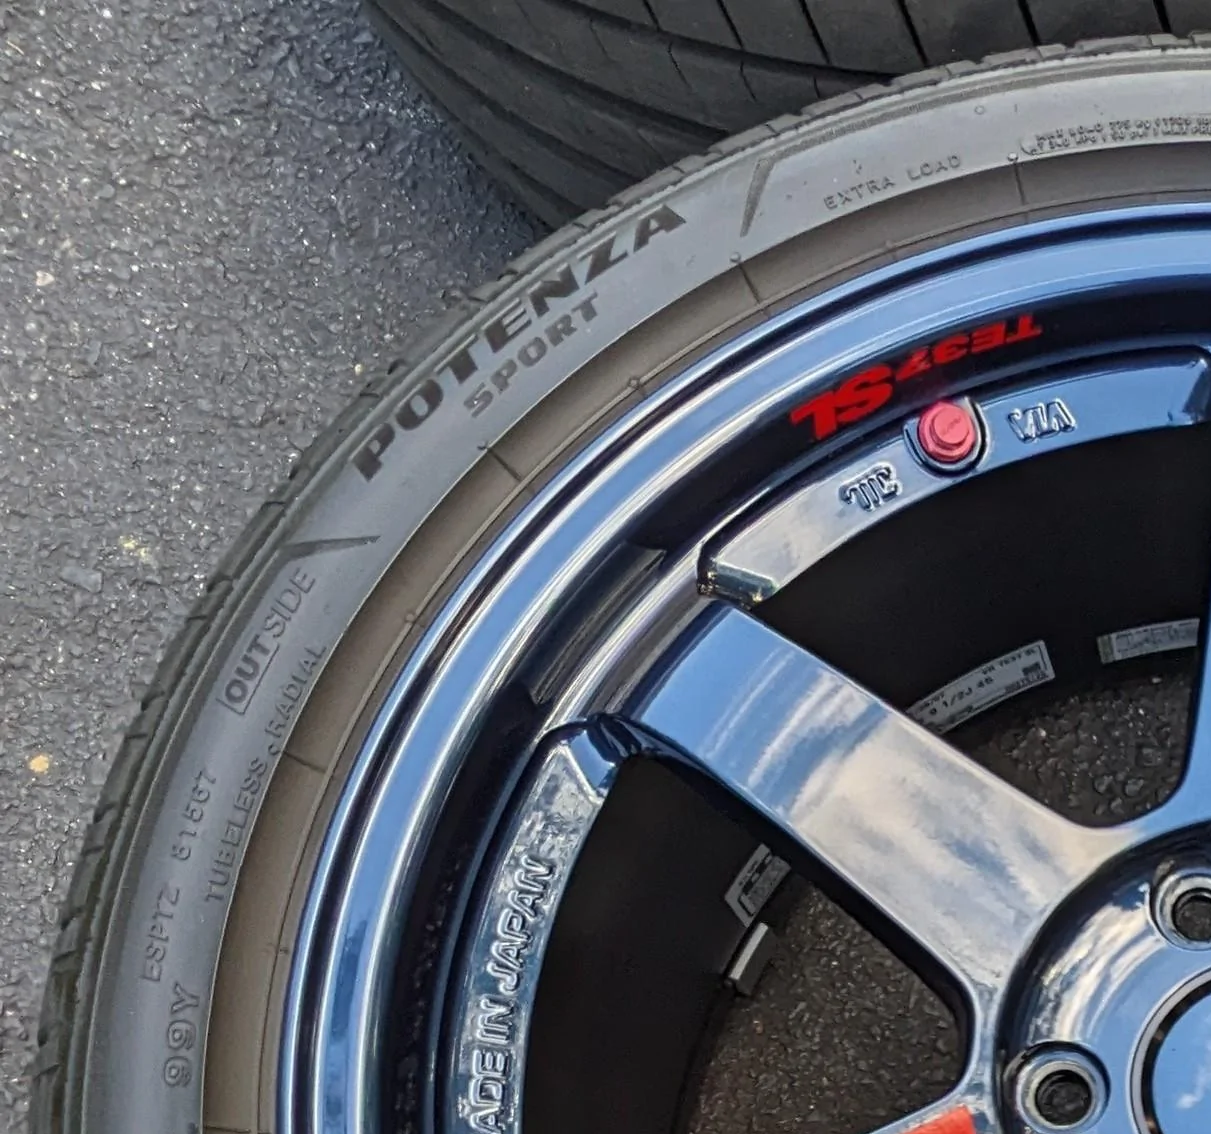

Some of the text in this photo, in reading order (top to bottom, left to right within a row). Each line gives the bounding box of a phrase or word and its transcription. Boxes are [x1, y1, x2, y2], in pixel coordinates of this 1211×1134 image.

[823, 153, 962, 210] EXTRA LOAD
[349, 203, 688, 483] POTENZA
[463, 296, 600, 420] SPORT
[222, 569, 316, 708] OUTSIDE
[205, 644, 327, 903] TUBELESS RADIAL
[487, 856, 556, 996] JAPAN
[163, 982, 200, 1087] 99Y
[475, 997, 515, 1044] IN
